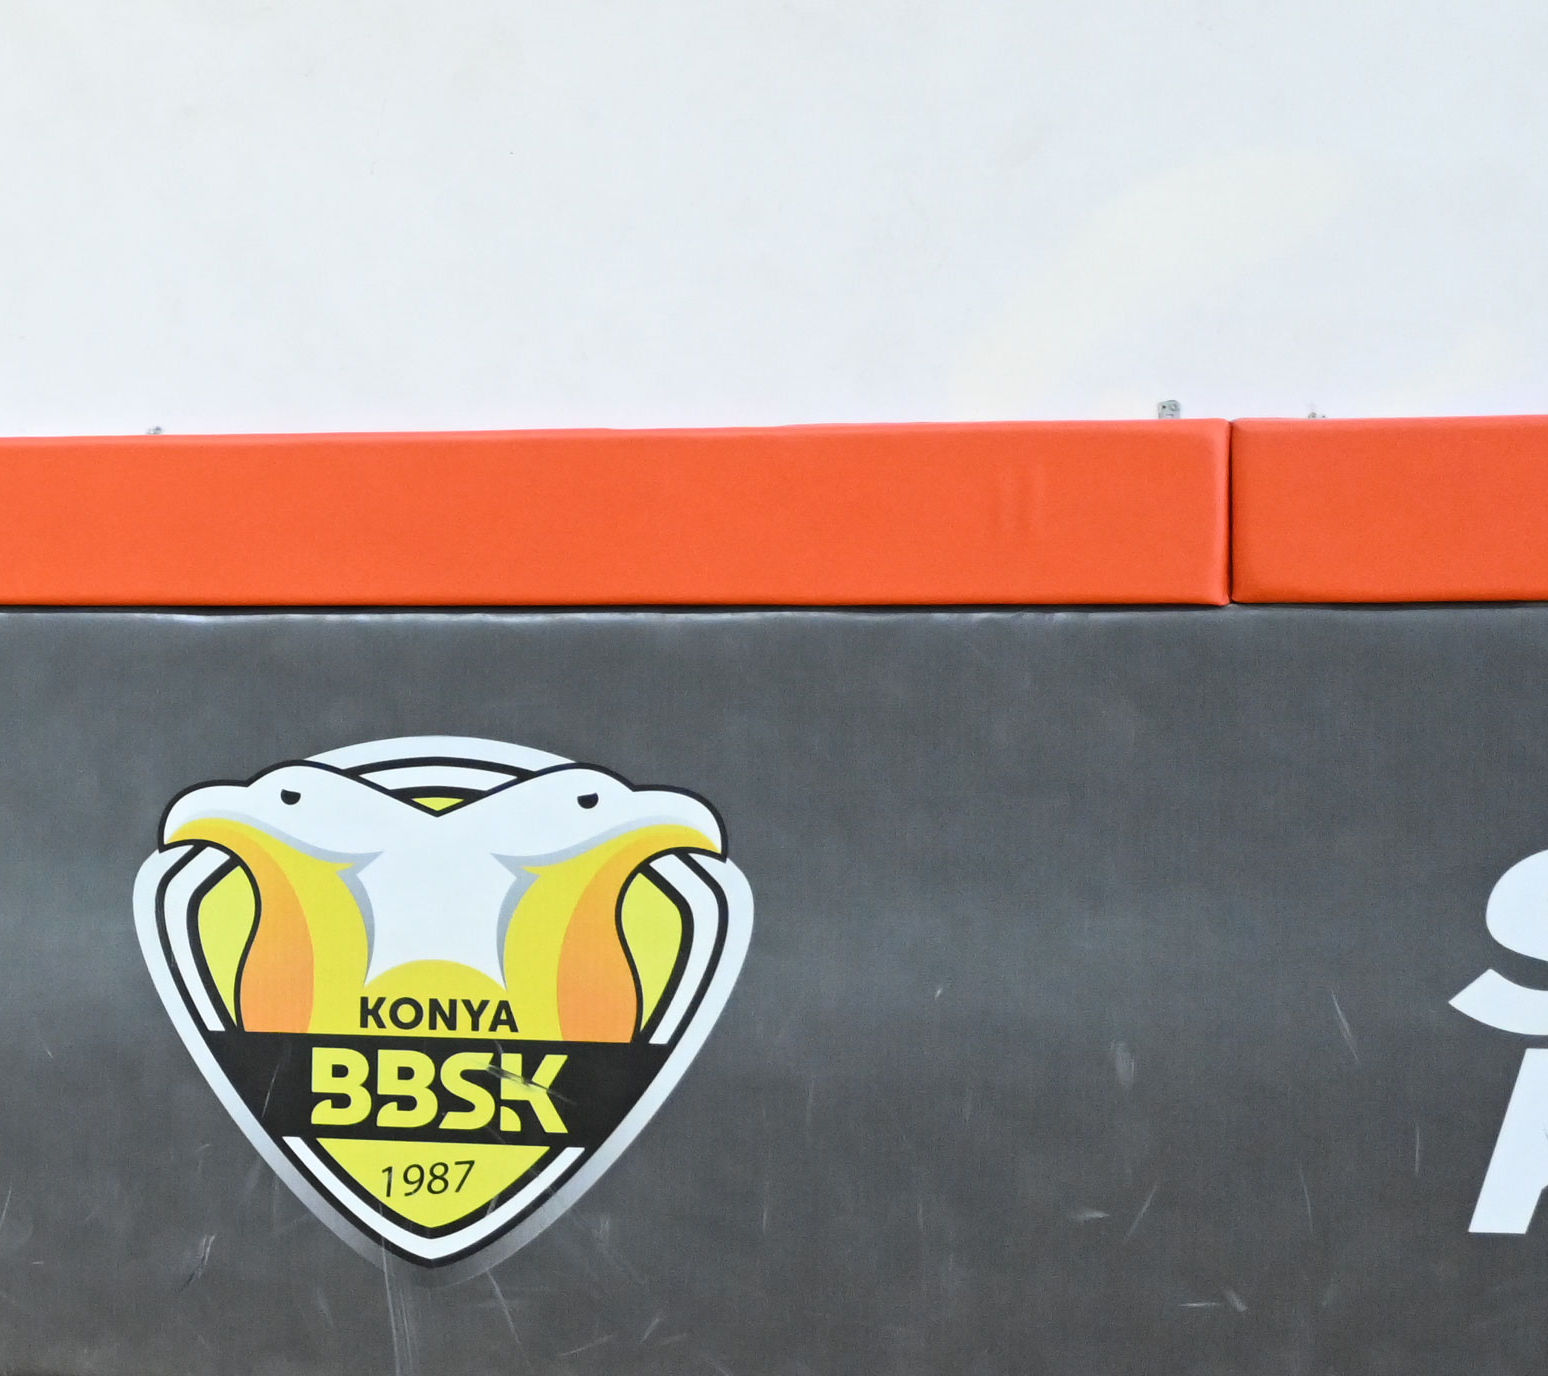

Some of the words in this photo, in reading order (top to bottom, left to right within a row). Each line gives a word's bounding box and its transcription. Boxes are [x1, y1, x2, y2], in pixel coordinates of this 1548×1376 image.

[359, 996, 519, 1033] KONYA
[310, 1047, 569, 1134] BBSK
[381, 1160, 475, 1197] 1987
